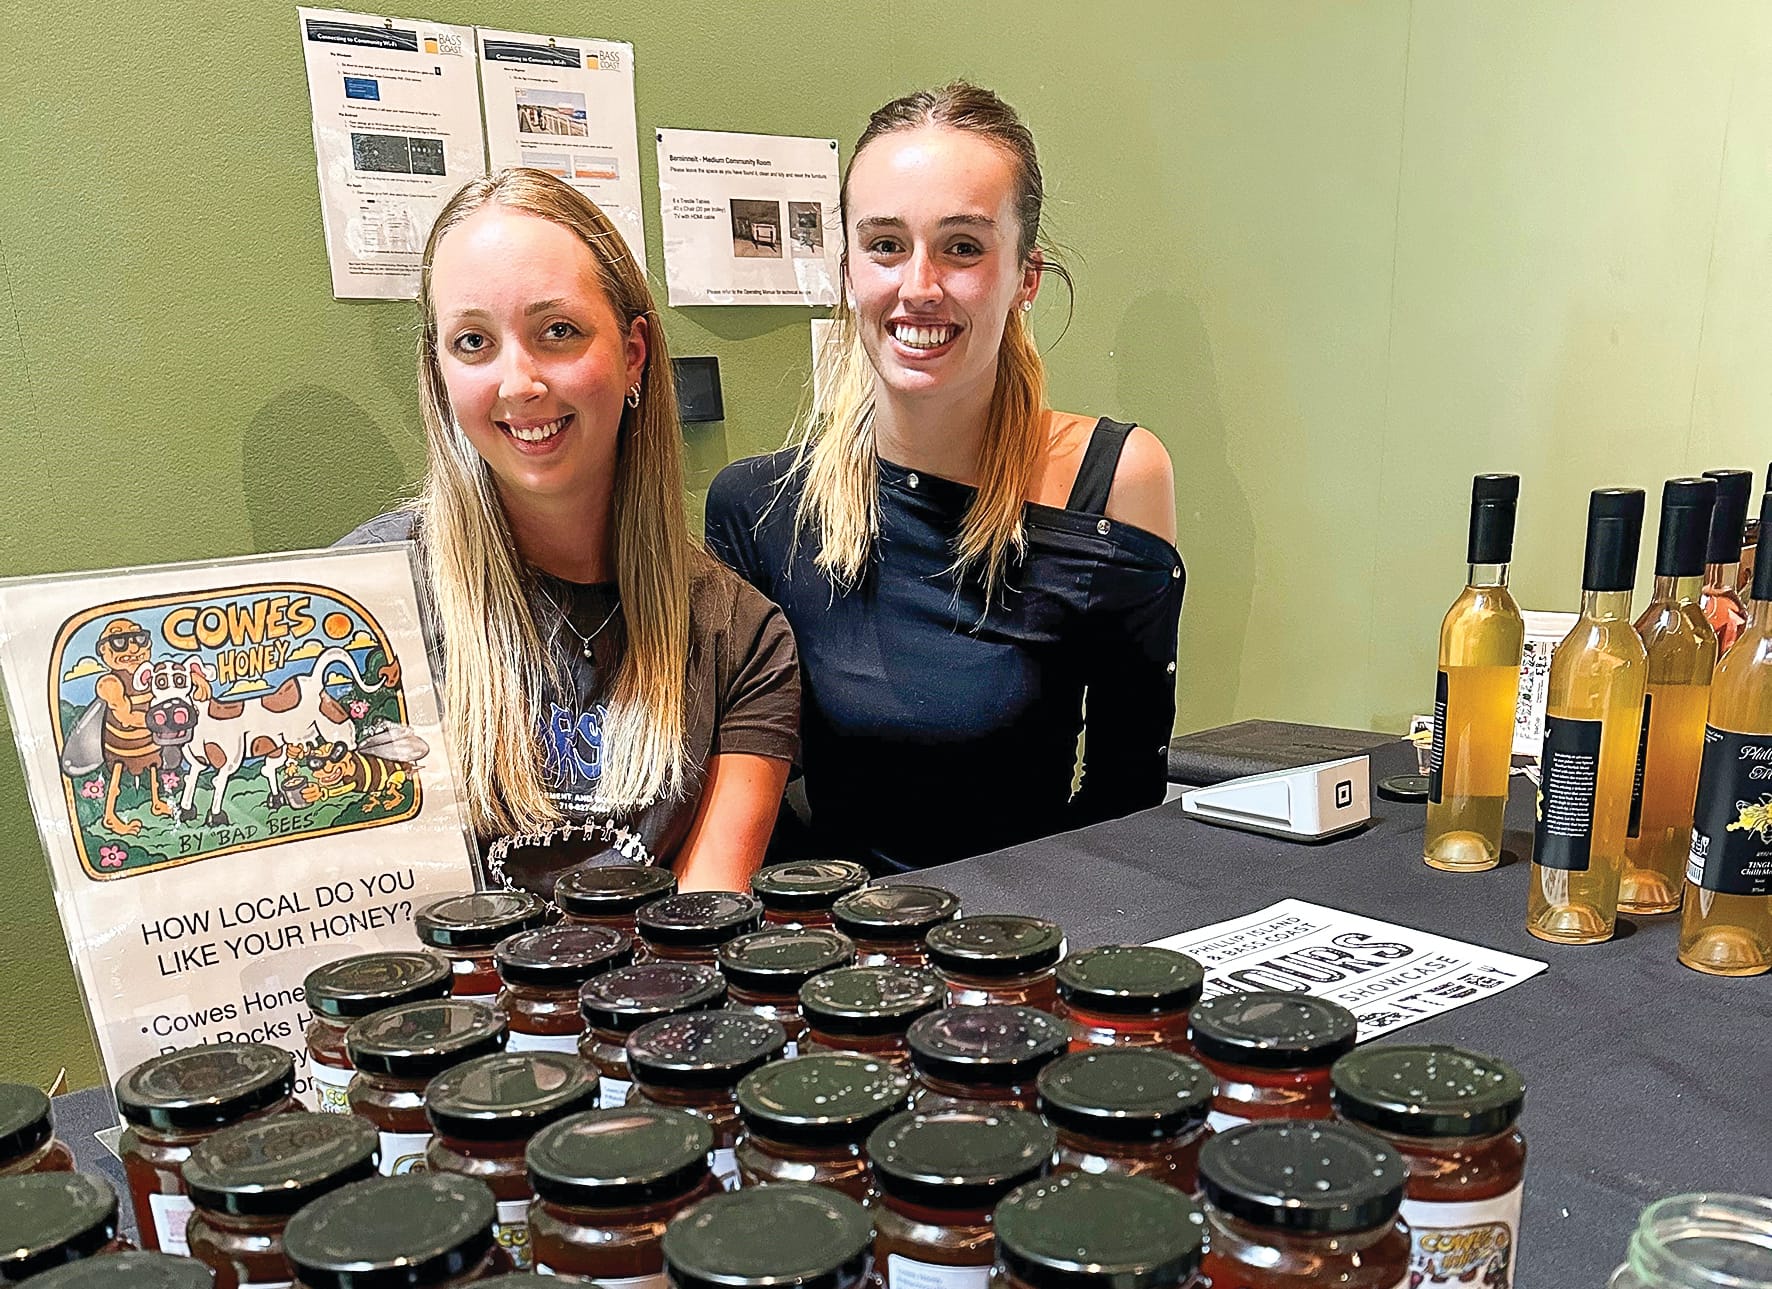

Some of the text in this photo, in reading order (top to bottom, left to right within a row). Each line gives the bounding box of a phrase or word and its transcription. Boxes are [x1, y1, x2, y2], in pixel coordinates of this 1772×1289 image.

[317, 32, 348, 44] Connecting
[354, 36, 383, 47] Community
[438, 33, 462, 45] BASS
[440, 44, 462, 54] COAST
[600, 50, 620, 61] BASS
[496, 54, 522, 63] Connecting
[528, 56, 553, 65] Community
[600, 60, 620, 70] COAST
[702, 156, 724, 164] Medium
[726, 157, 756, 167] Community
[756, 159, 772, 167] Room
[161, 595, 316, 651] COWES
[217, 638, 291, 686] HONEY
[179, 834, 203, 854] BY
[141, 868, 415, 946] HOW LOCAL DO YOU
[157, 900, 412, 976] LIKE YOUR HONEY?
[1188, 916, 1301, 956] PHILLIP ISLAND
[1206, 922, 1317, 962] & BASS COAST
[1208, 932, 1414, 997] OURS
[1338, 955, 1460, 1002] SHOWCASE
[152, 986, 306, 1037] Cowes Hone
